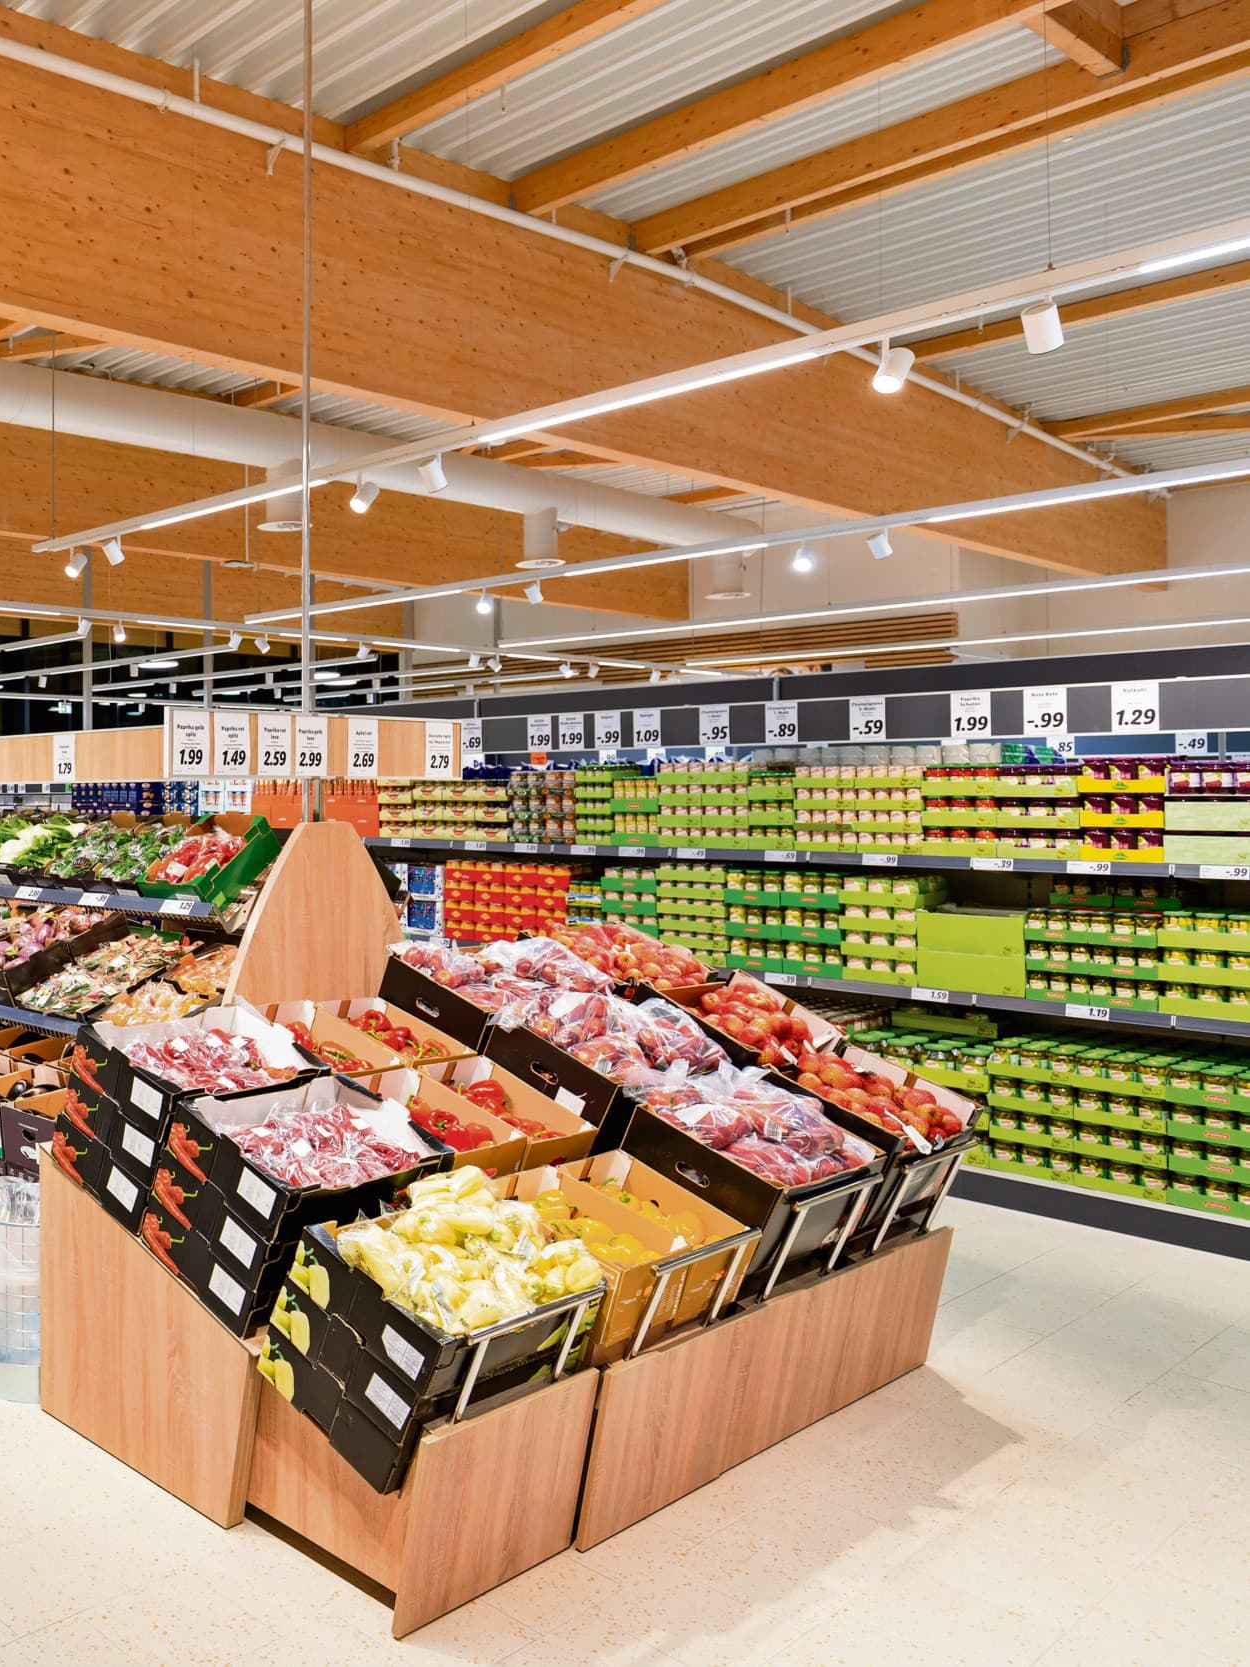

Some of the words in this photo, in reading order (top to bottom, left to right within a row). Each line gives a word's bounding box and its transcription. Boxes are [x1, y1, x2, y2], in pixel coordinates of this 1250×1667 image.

[954, 716, 988, 731] 1.99
[1027, 712, 1064, 728] -.99
[1115, 708, 1156, 726] 1.29
[702, 726, 729, 740] -.95
[768, 723, 796, 737] -.89
[852, 720, 883, 735] -.59
[462, 737, 481, 748] -.69
[530, 734, 550, 746] 1.99
[561, 732, 583, 745] 1.99
[597, 730, 619, 743] -.99
[636, 729, 659, 742] 1.09
[1177, 738, 1205, 750] -.49
[179, 749, 203, 765] 1.99
[222, 750, 246, 766] 1.49
[264, 751, 287, 766] 2.59
[299, 752, 322, 767] 2.99
[353, 753, 375, 767] 2.69
[430, 755, 450, 769] 2.79
[58, 762, 72, 775] 1.79
[1225, 867, 1248, 877] -.99
[930, 991, 948, 999] 1.59
[1088, 1008, 1108, 1018] 1.19
